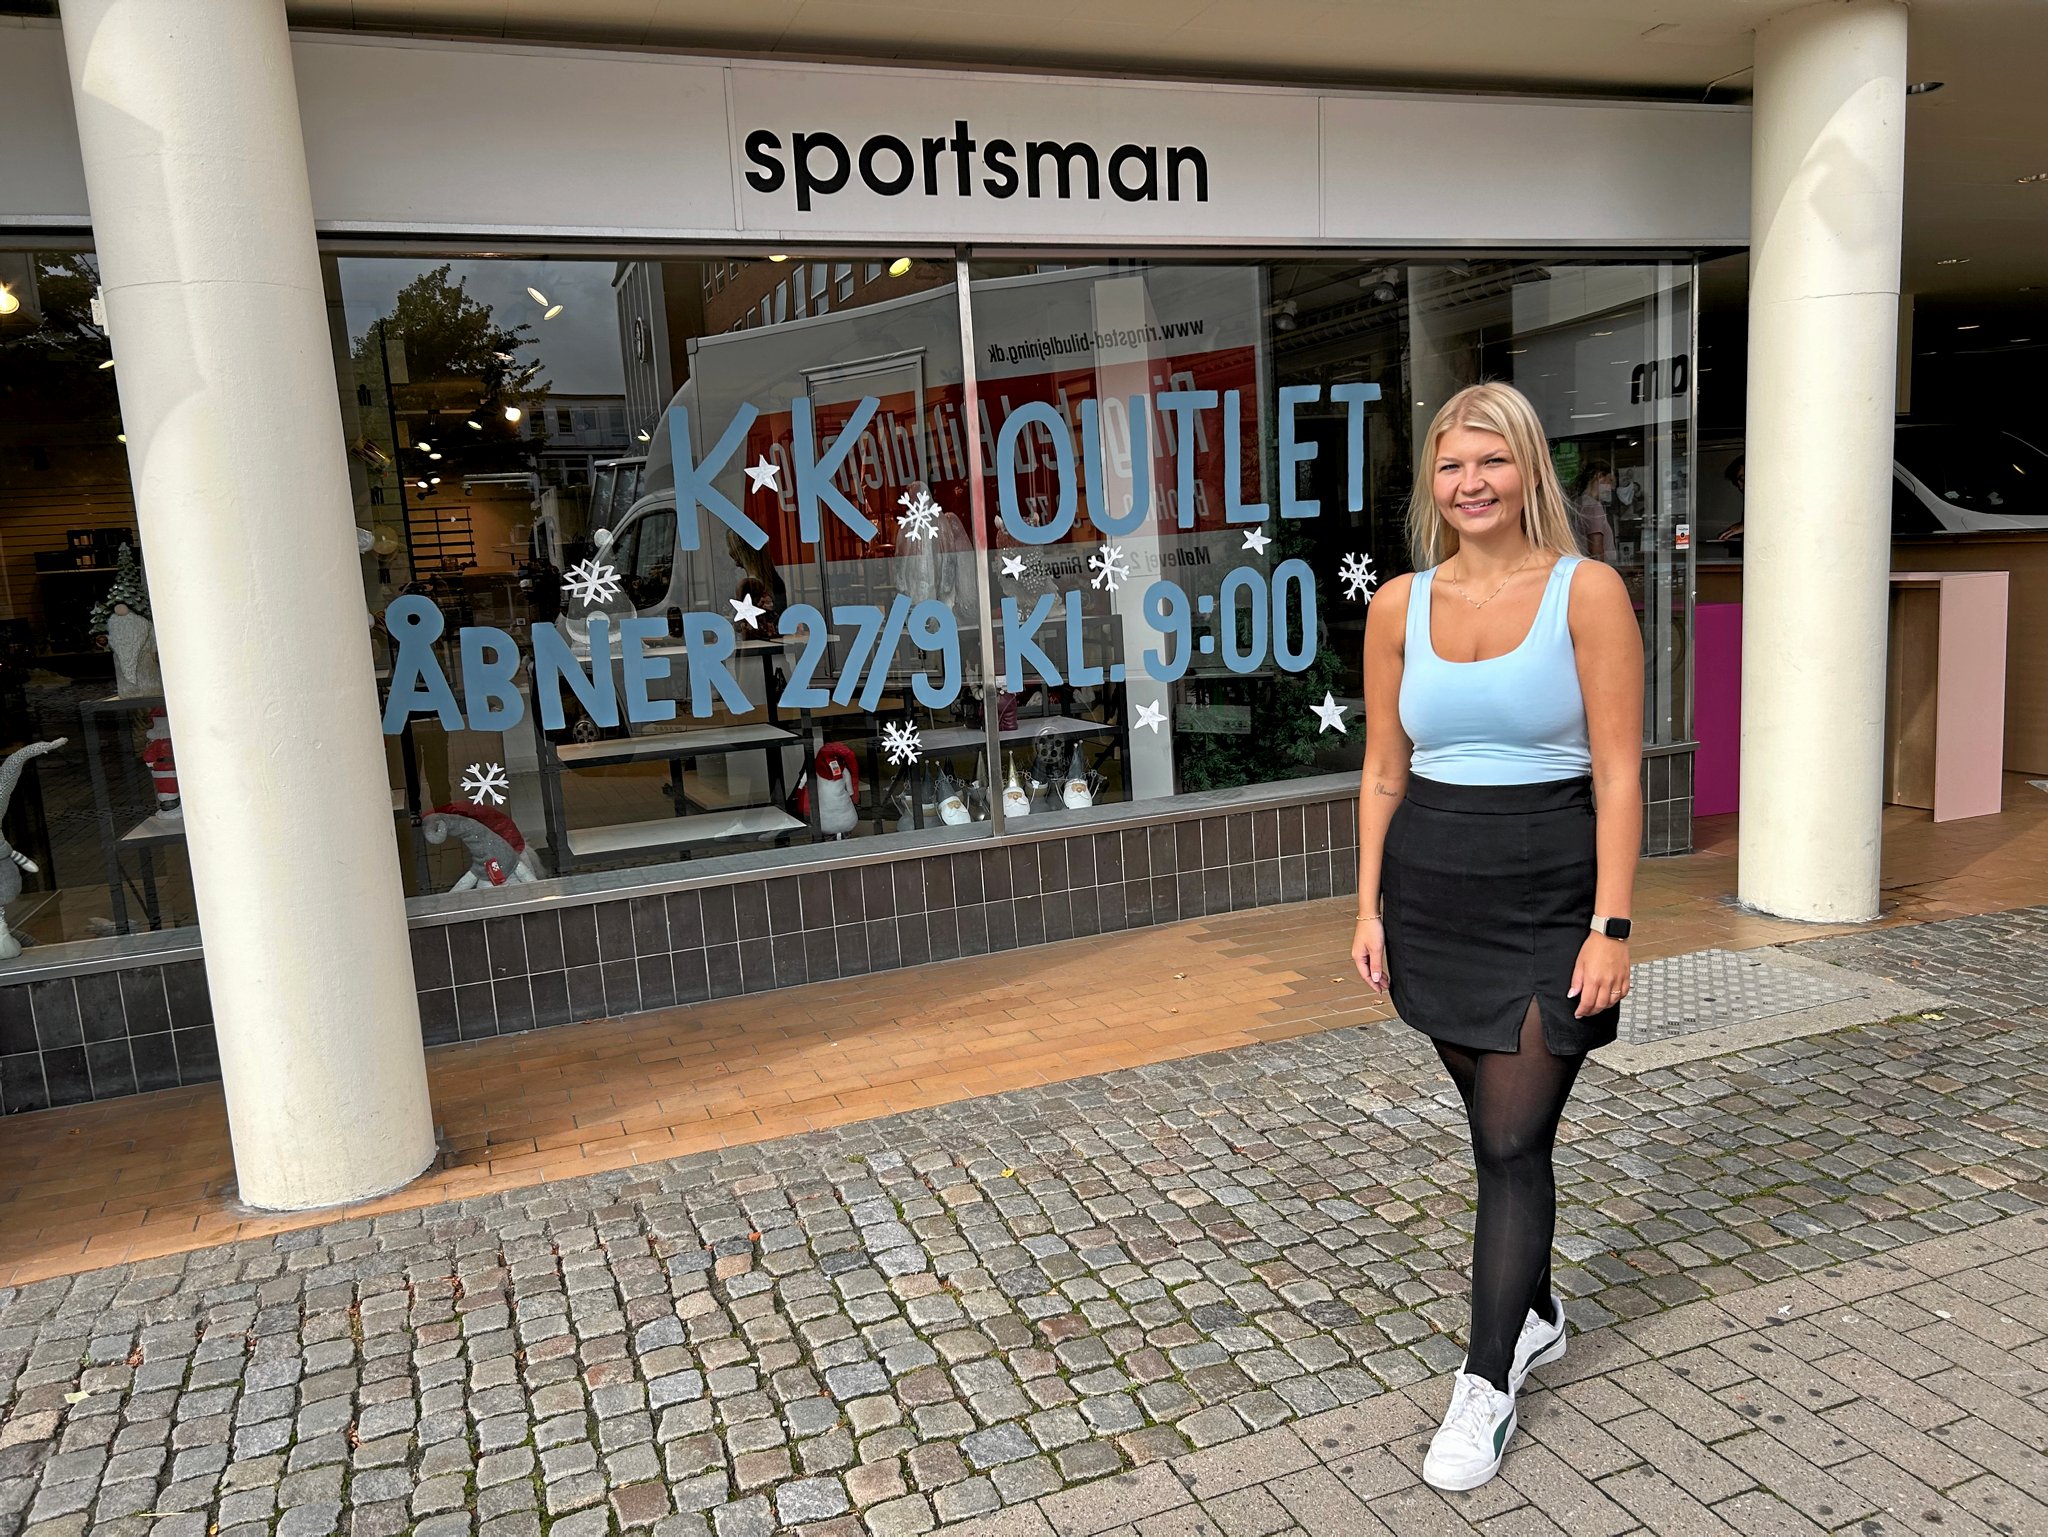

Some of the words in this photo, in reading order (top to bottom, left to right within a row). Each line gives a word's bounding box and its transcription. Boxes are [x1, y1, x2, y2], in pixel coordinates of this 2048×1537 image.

[744, 120, 1209, 211] sportsman
[997, 383, 1382, 544] OUTLET
[382, 594, 755, 735] ÅBNER
[778, 594, 962, 712] 27/9
[1001, 590, 1126, 693] KL.
[1143, 558, 1318, 683] 9:00
